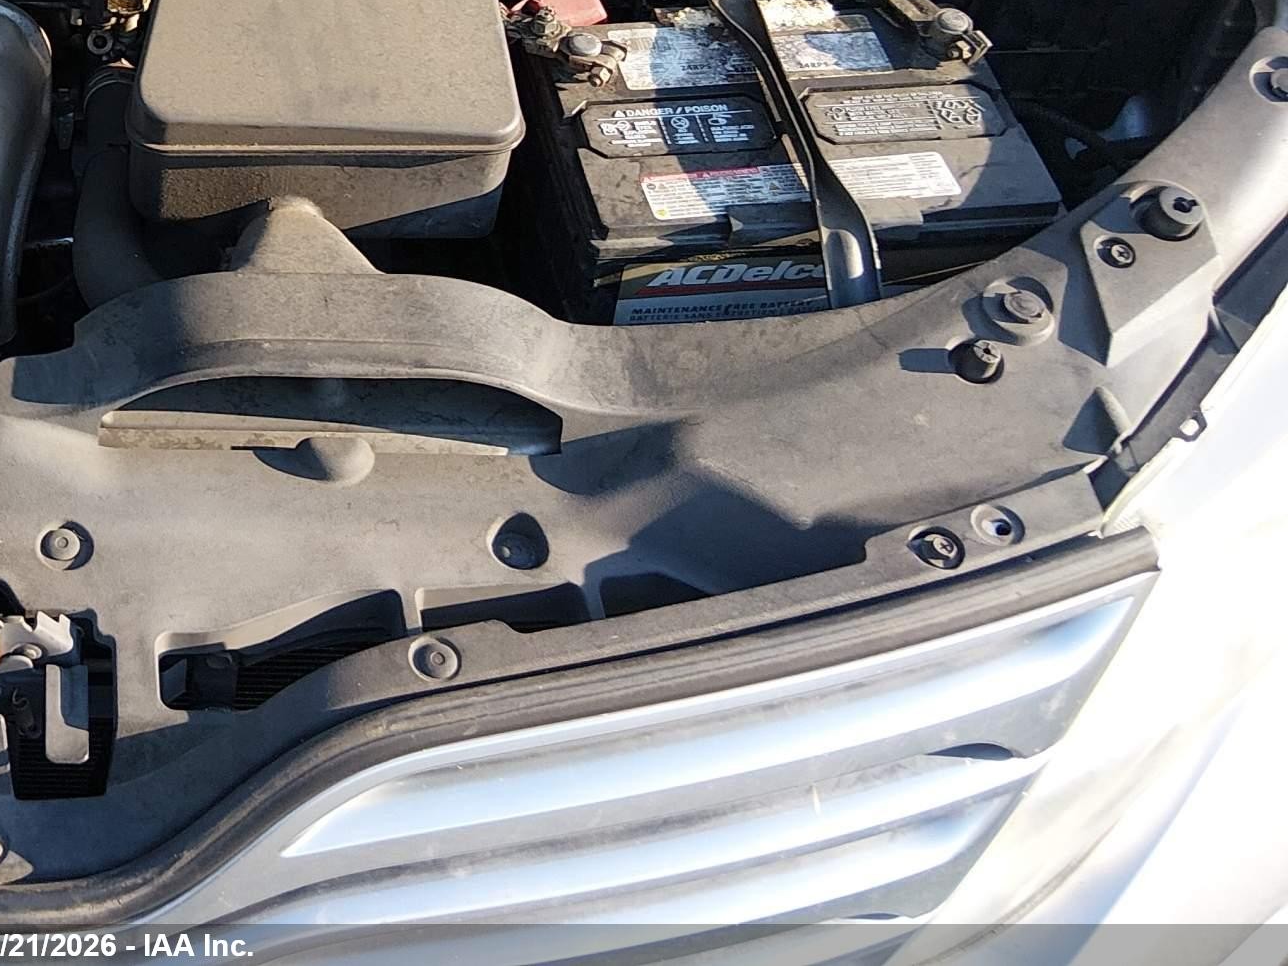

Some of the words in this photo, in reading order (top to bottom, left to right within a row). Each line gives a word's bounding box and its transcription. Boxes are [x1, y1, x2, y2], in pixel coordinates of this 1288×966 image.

[626, 107, 674, 117] DANGER
[684, 104, 728, 114] POISON
[631, 304, 722, 314] MAINTENANCE
